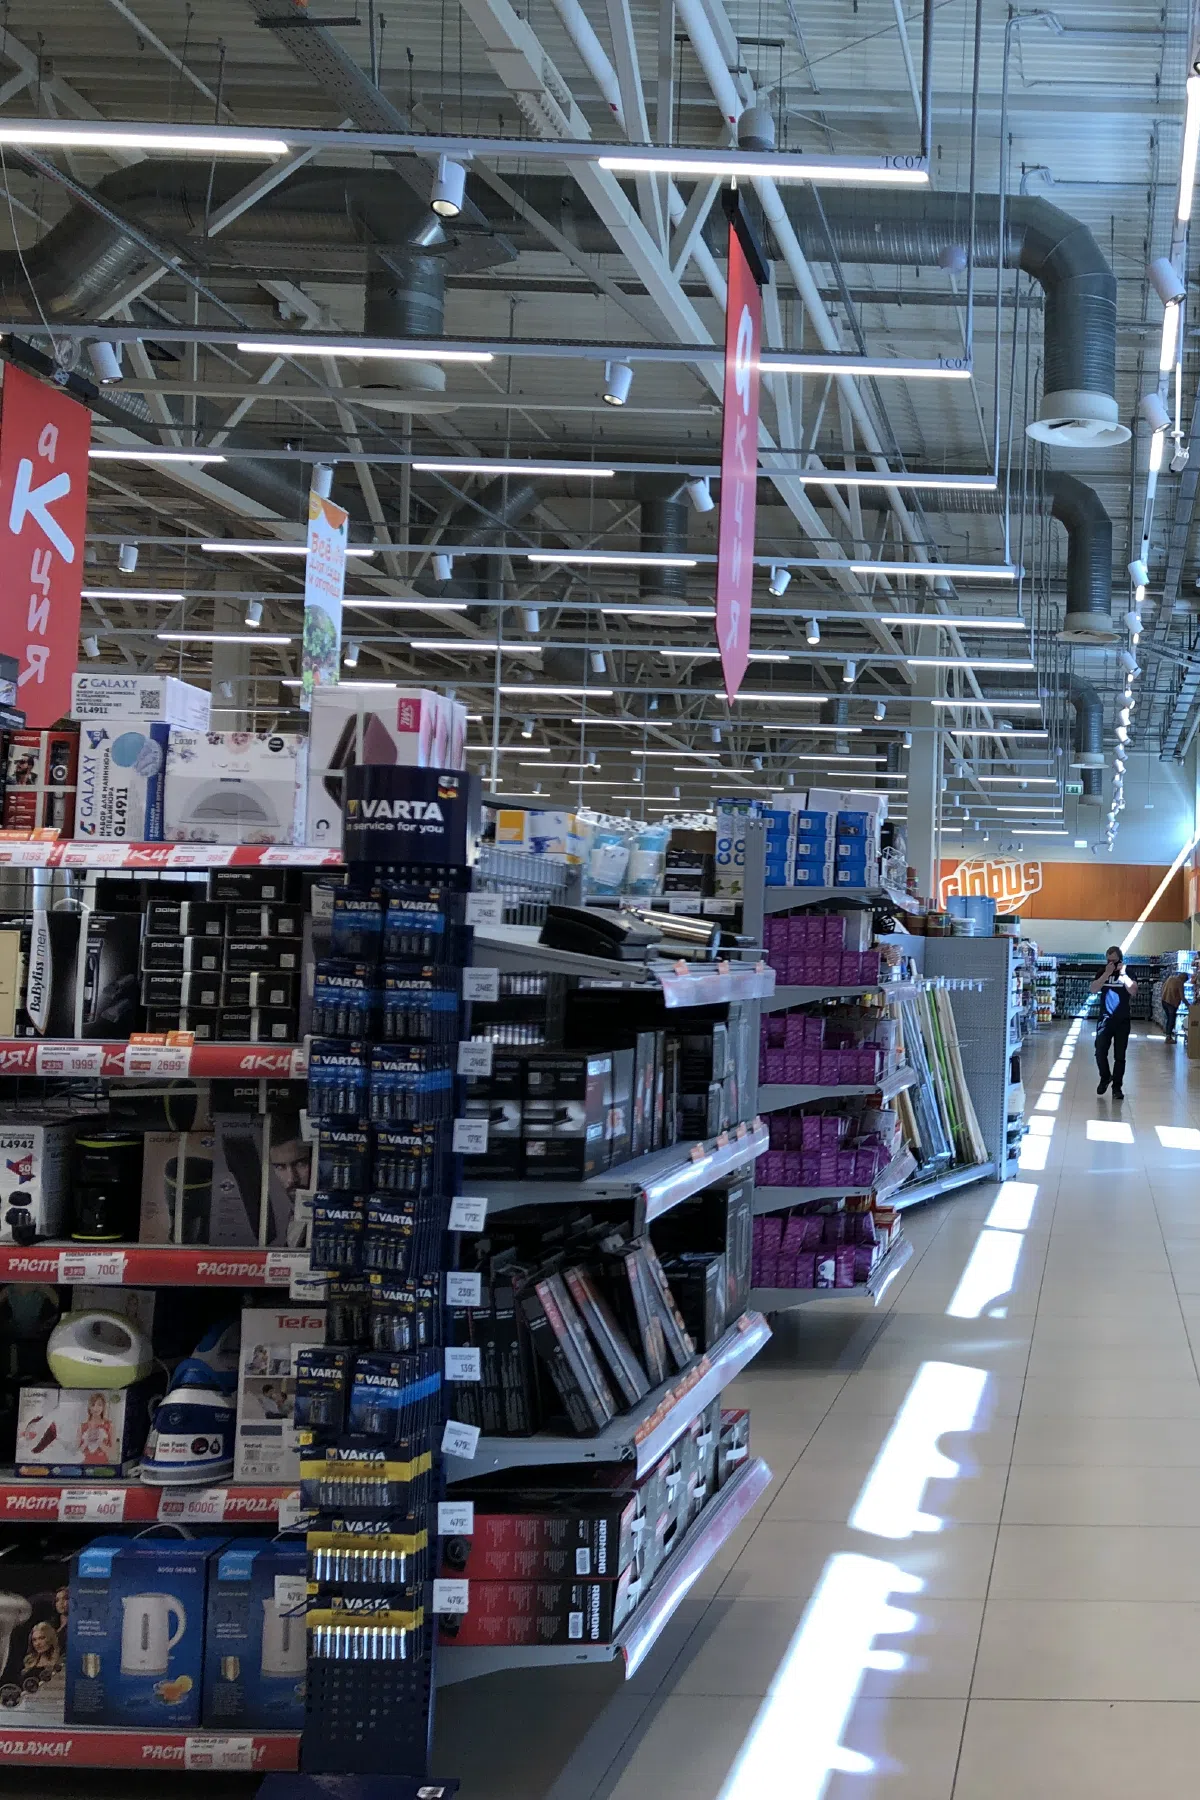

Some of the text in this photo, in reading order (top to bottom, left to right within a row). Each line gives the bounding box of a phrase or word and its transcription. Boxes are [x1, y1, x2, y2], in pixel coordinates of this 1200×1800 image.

[91, 678, 138, 689] GALAXY
[81, 755, 97, 817] GALAXY
[114, 787, 128, 837] GL4911
[362, 799, 444, 821] VARTA
[353, 822, 395, 831] service
[396, 821, 417, 832] for
[419, 823, 444, 834] you
[345, 900, 381, 910] VARTA
[401, 901, 439, 912] VARTA
[37, 927, 46, 955] men
[328, 976, 364, 988] VARTA
[396, 980, 432, 990] VARTA
[72, 1059, 94, 1070] 1999
[321, 1056, 361, 1066] VARTA
[383, 1061, 420, 1072] VARTA
[234, 1087, 289, 1097] polris
[331, 1131, 368, 1143] VARTA
[387, 1134, 423, 1145] VARTA
[326, 1209, 363, 1220] VARTA
[378, 1214, 413, 1225] VARTA
[97, 1264, 116, 1276] 700
[382, 1290, 415, 1302] VARTA
[275, 1315, 324, 1329] Tefa
[310, 1368, 342, 1379] VARTA
[364, 1374, 399, 1388] VARTA
[338, 1449, 386, 1461] VARTA
[598, 1519, 607, 1574] REDMOND
[590, 1584, 600, 1640] REDMOND
